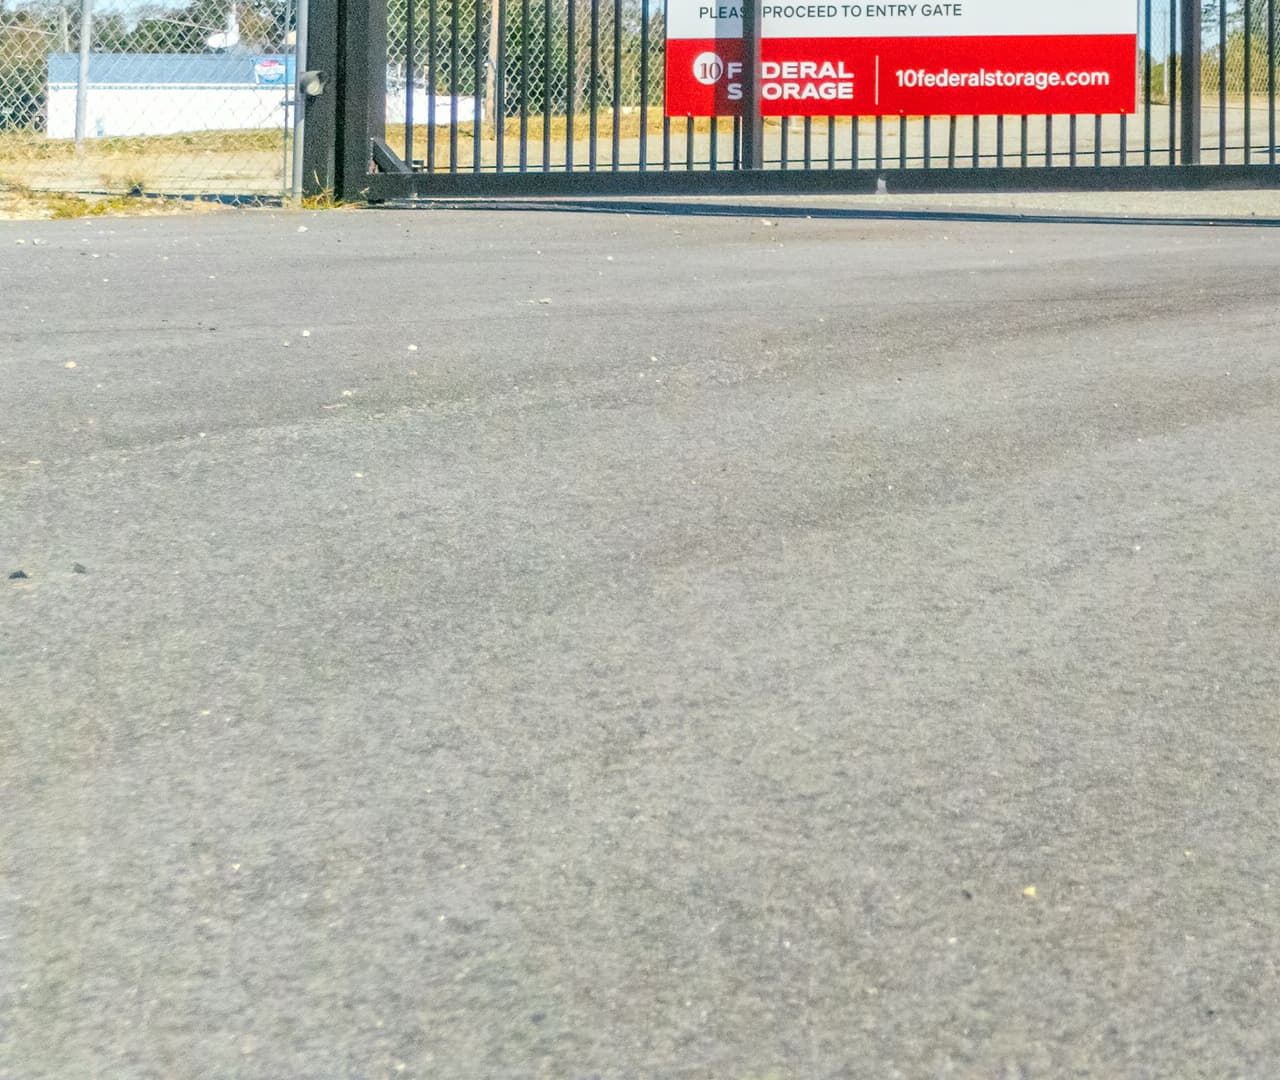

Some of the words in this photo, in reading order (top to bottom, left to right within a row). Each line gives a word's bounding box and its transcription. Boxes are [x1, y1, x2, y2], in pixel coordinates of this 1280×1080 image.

[699, 6, 753, 19] PLEAS
[762, 5, 837, 18] PROCEED
[841, 5, 862, 17] TO
[866, 4, 917, 17] ENTRY
[921, 3, 962, 16] GATE
[700, 62, 722, 80] 10
[727, 61, 854, 79] FDERAL
[896, 68, 1110, 90] 10federalstorage.com
[727, 82, 854, 100] SORAGE
